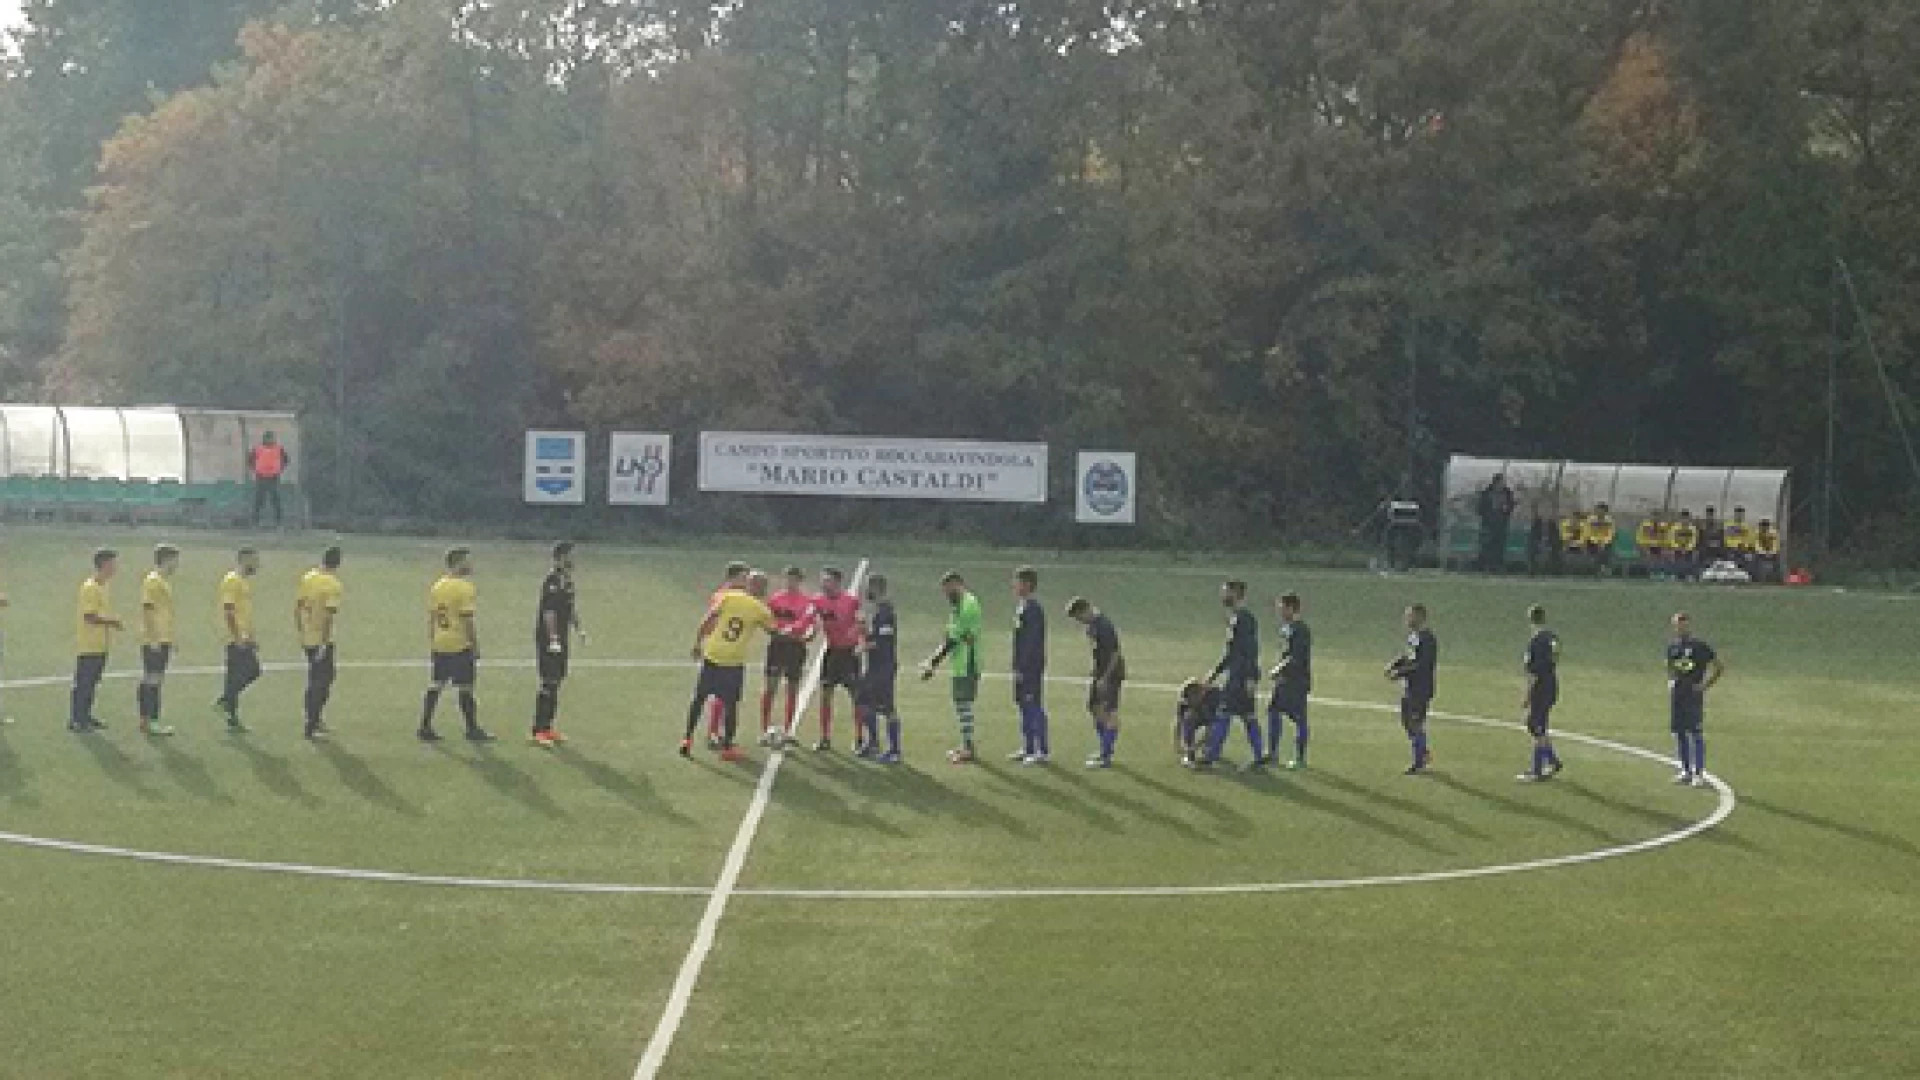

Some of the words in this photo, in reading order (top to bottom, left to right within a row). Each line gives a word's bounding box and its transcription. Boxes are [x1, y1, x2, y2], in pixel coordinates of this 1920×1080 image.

[714, 443, 775, 458] CAMPO
[780, 445, 870, 461] SPORTIVO
[746, 463, 848, 485] "MARIO
[857, 468, 998, 491] CASTALDI"
[722, 616, 744, 642] 9
